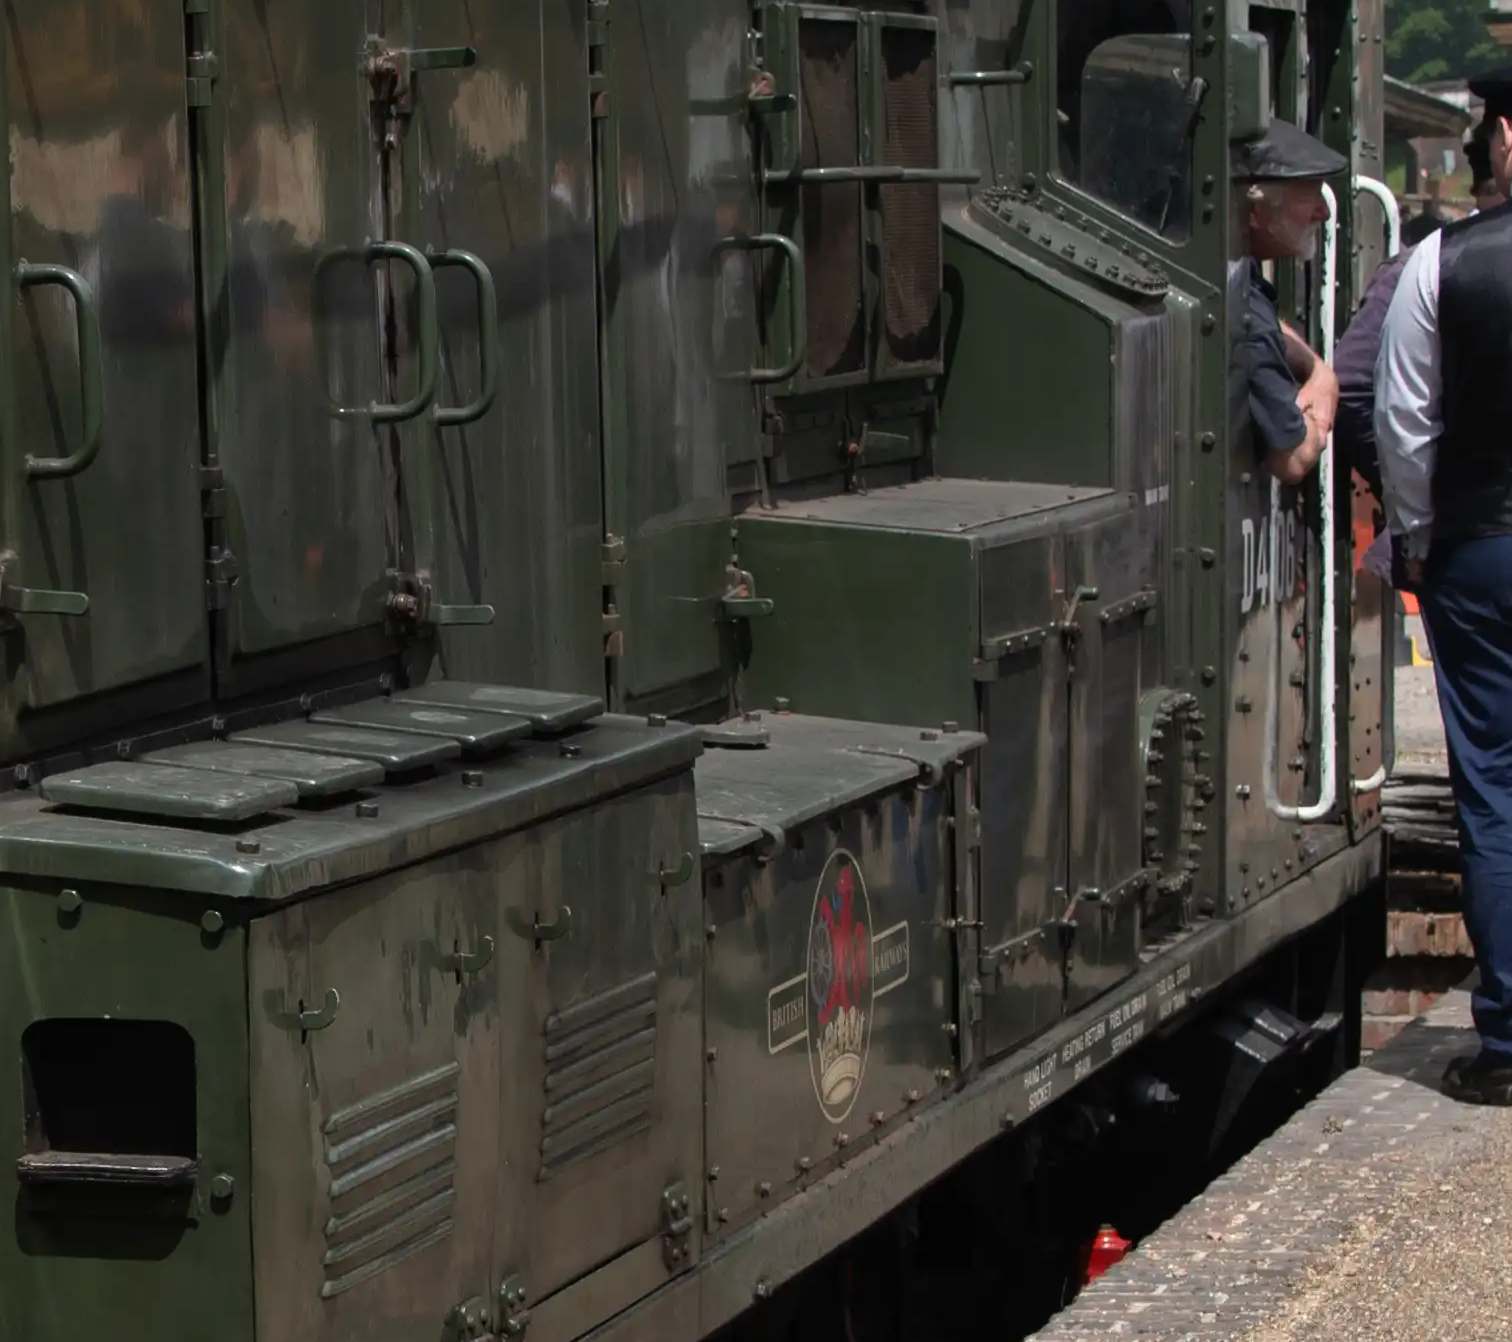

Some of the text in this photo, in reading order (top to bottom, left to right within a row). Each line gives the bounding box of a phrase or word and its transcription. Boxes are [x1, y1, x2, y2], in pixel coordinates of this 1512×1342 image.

[1241, 508, 1295, 614] D406
[772, 995, 804, 1032] BRITISH
[1109, 993, 1147, 1031] FUEL OIL DRAIN
[1062, 1021, 1105, 1064] HEATING RETURN
[1111, 1027, 1132, 1056] SERVICE
[1024, 1053, 1057, 1090] HAND LIGHT
[1074, 1055, 1091, 1081] DRAIN
[1029, 1081, 1052, 1112] SOCKET
